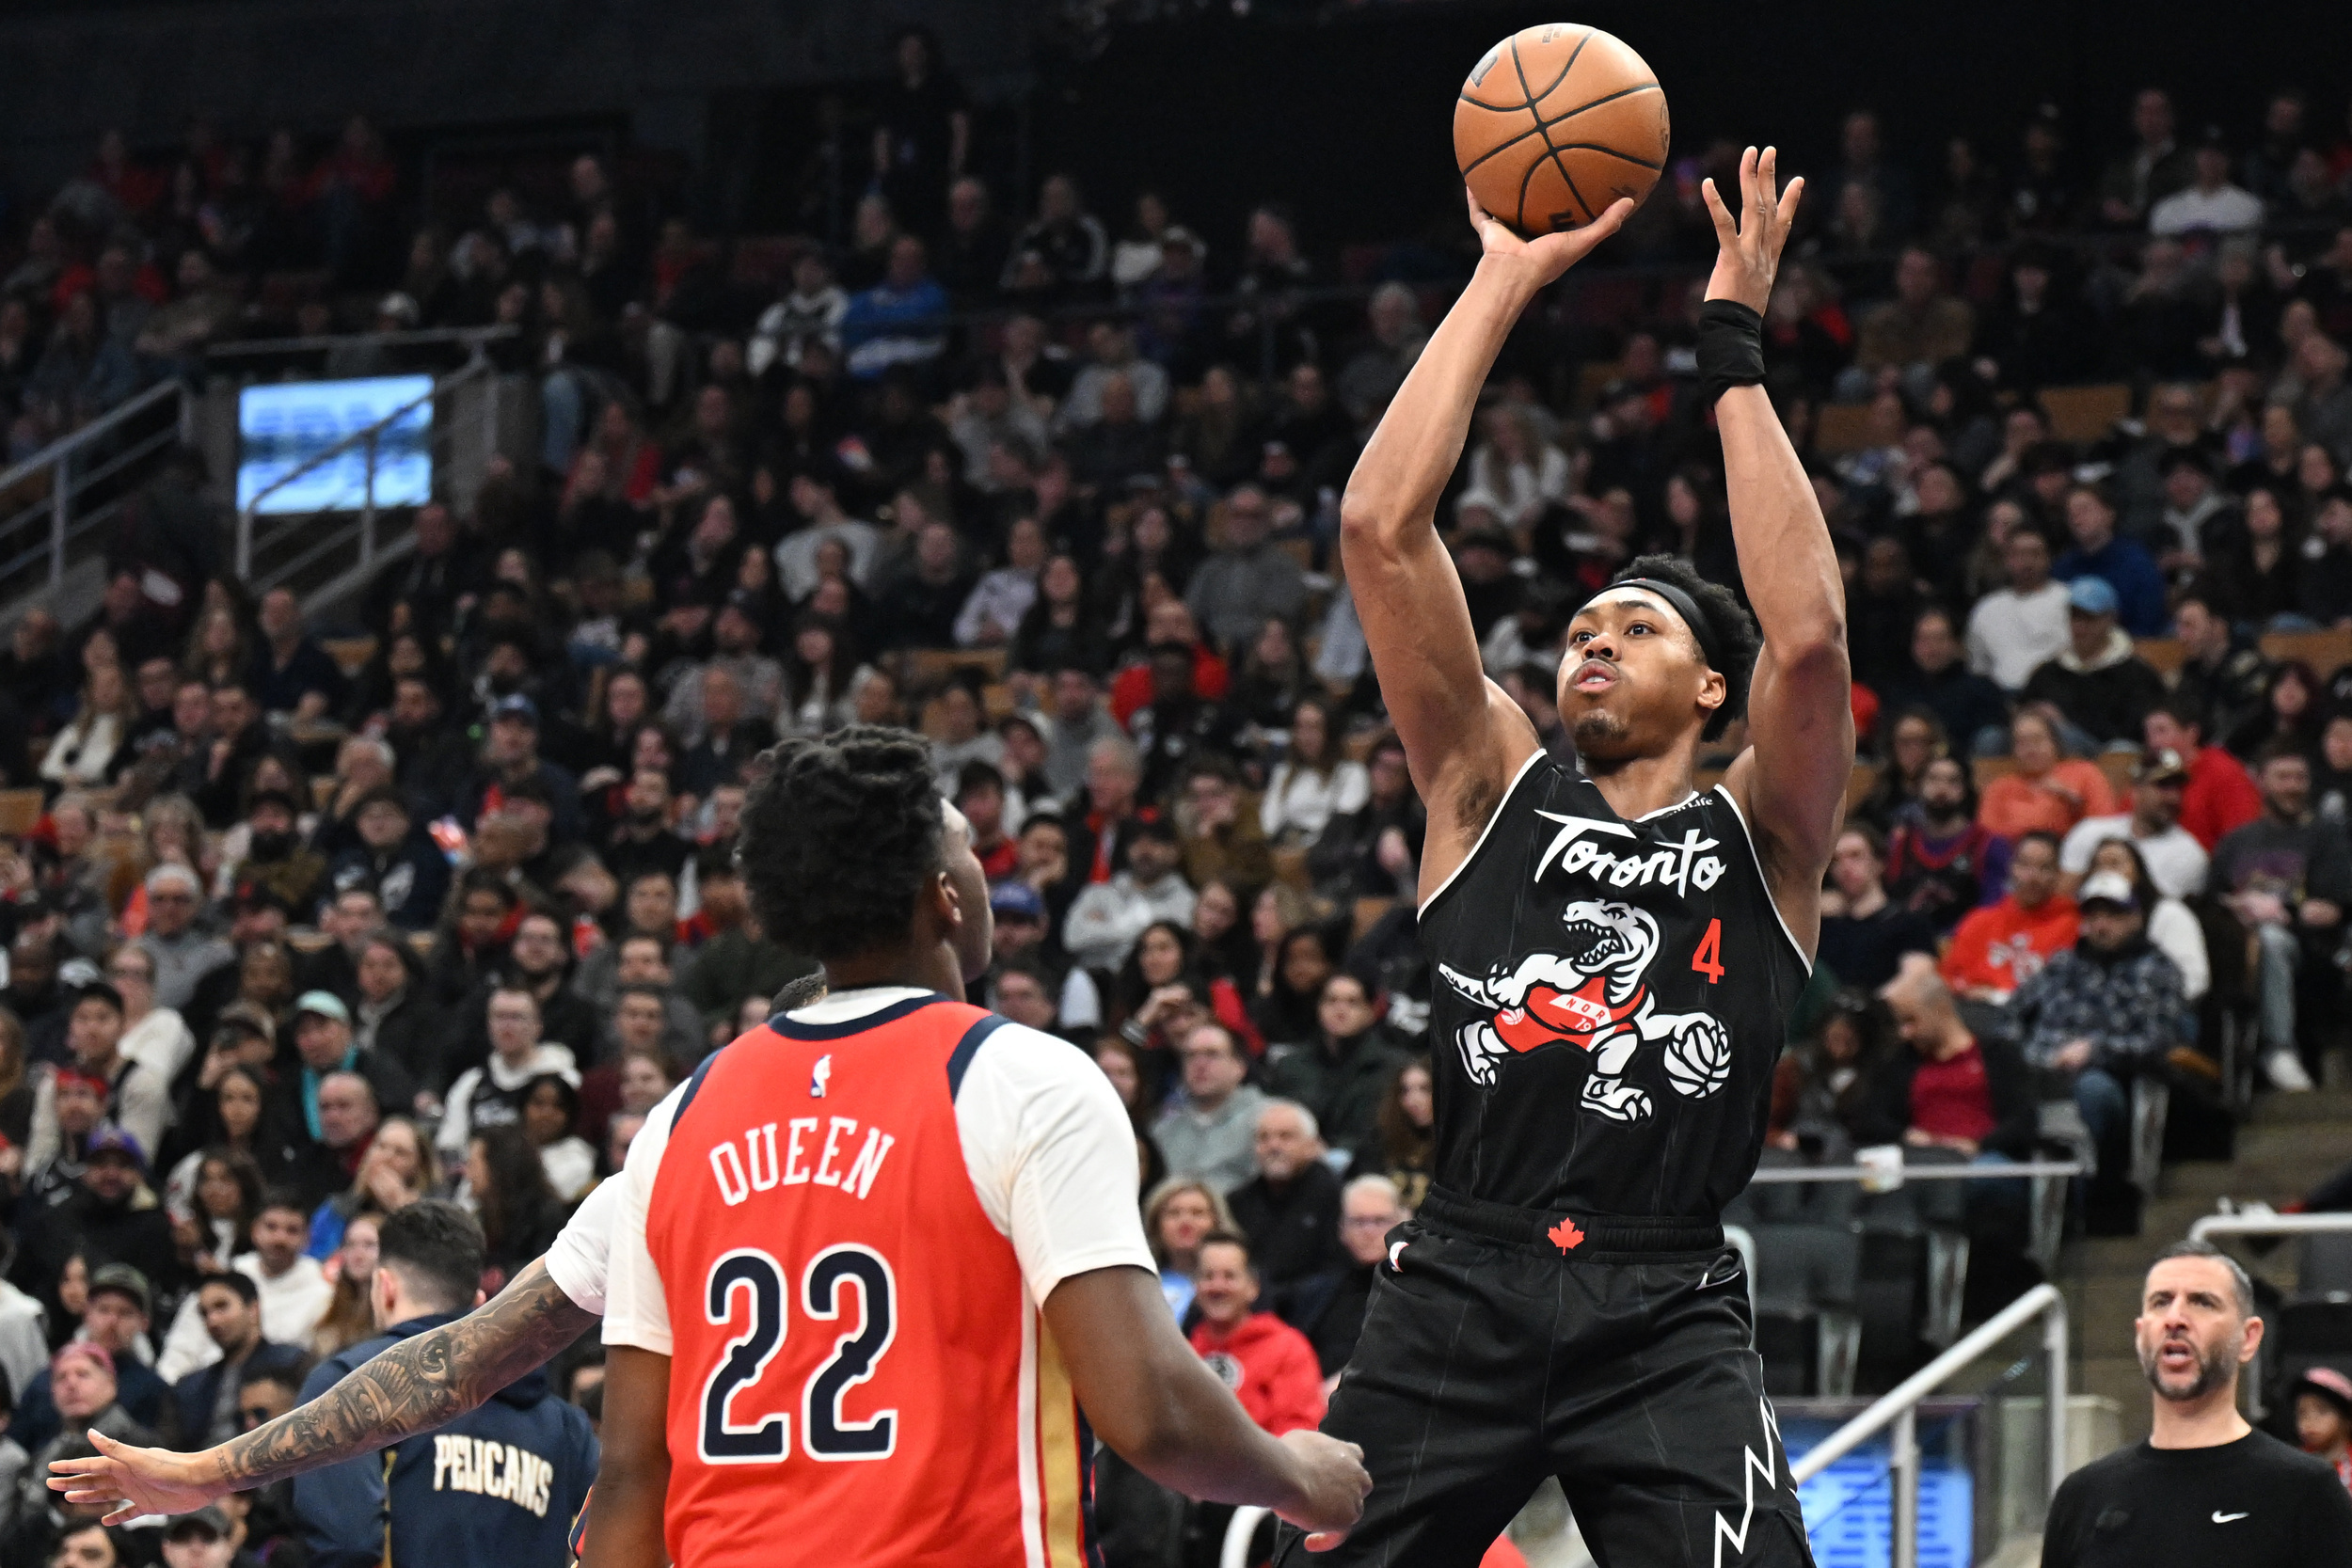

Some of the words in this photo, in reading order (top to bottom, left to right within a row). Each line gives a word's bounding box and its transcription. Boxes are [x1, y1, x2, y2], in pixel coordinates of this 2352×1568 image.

[1688, 797, 1713, 808] Life
[1534, 809, 1726, 898] Toronto
[1691, 918, 1725, 984] 4
[708, 1116, 895, 1206] QUEEN
[697, 1243, 898, 1465] 22
[433, 1433, 554, 1519] PELICANS
